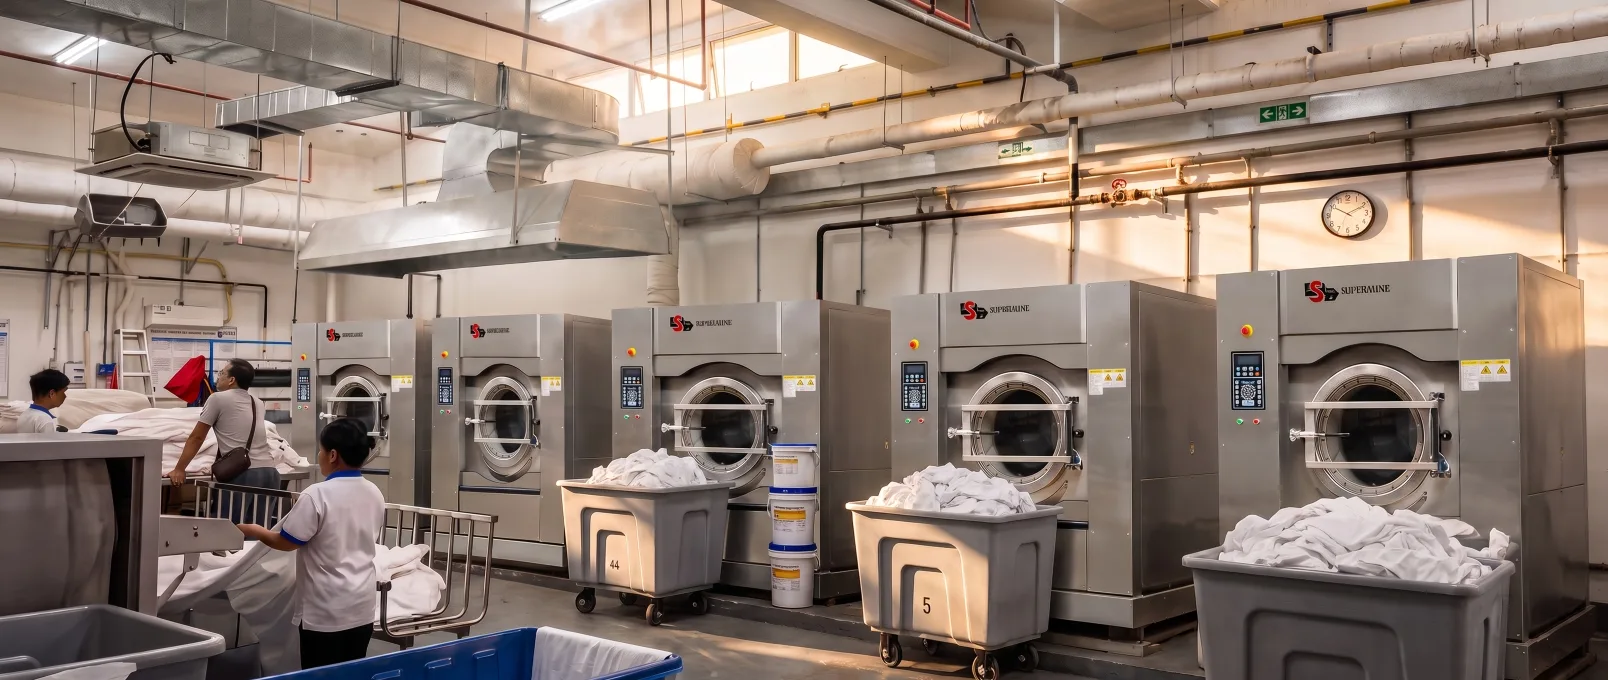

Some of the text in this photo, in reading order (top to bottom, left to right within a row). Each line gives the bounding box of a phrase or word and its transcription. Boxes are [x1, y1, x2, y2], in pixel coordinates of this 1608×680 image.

[1341, 284, 1391, 295] SUPERMINE
[610, 559, 620, 570] 44
[922, 596, 931, 615] 5
